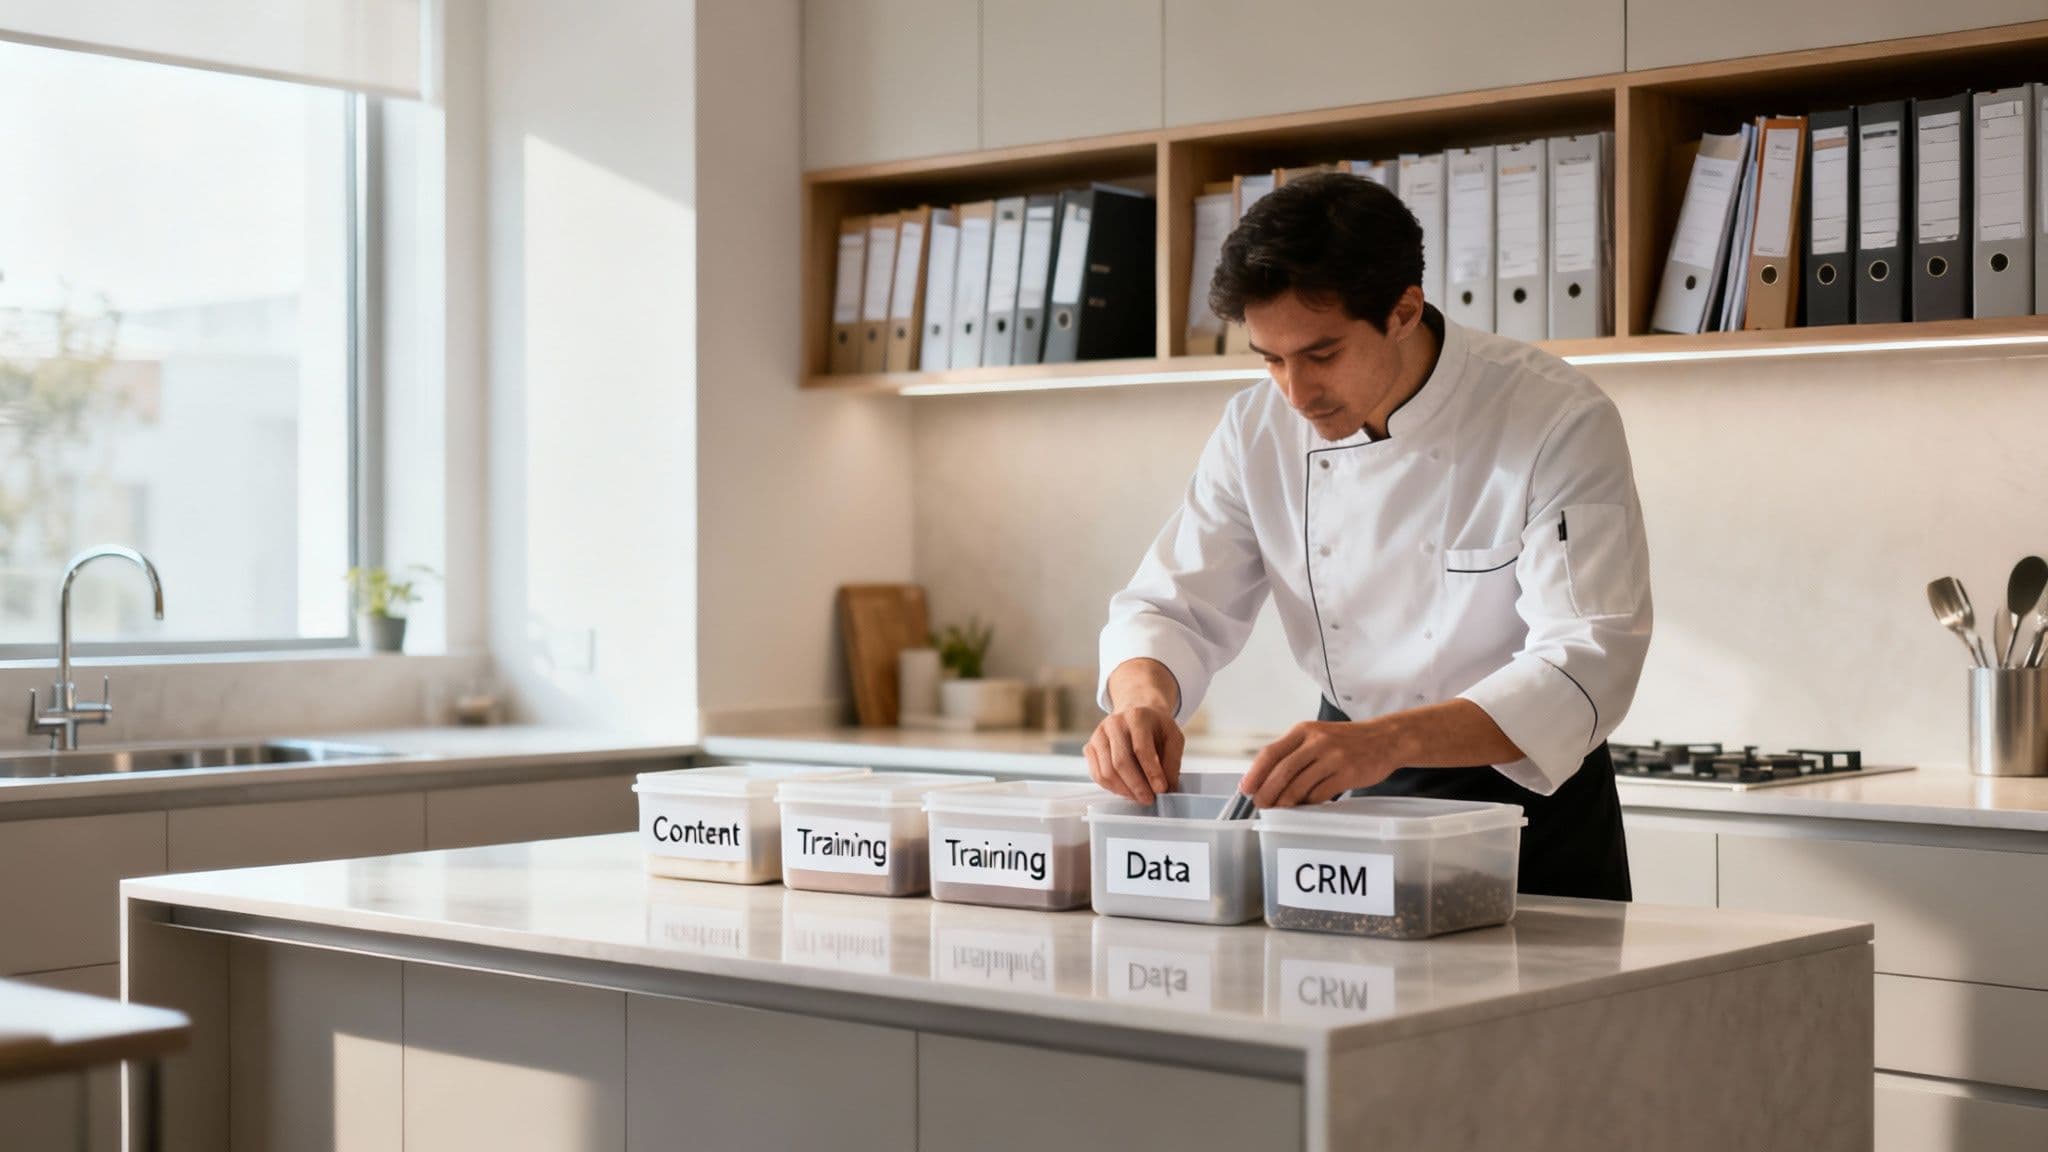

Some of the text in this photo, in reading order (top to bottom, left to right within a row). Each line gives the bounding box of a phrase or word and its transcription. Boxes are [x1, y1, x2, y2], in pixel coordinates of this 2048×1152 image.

[653, 815, 740, 847] Content
[944, 838, 1046, 881] Training
[1126, 850, 1190, 883] Data
[1295, 863, 1367, 897] CRM
